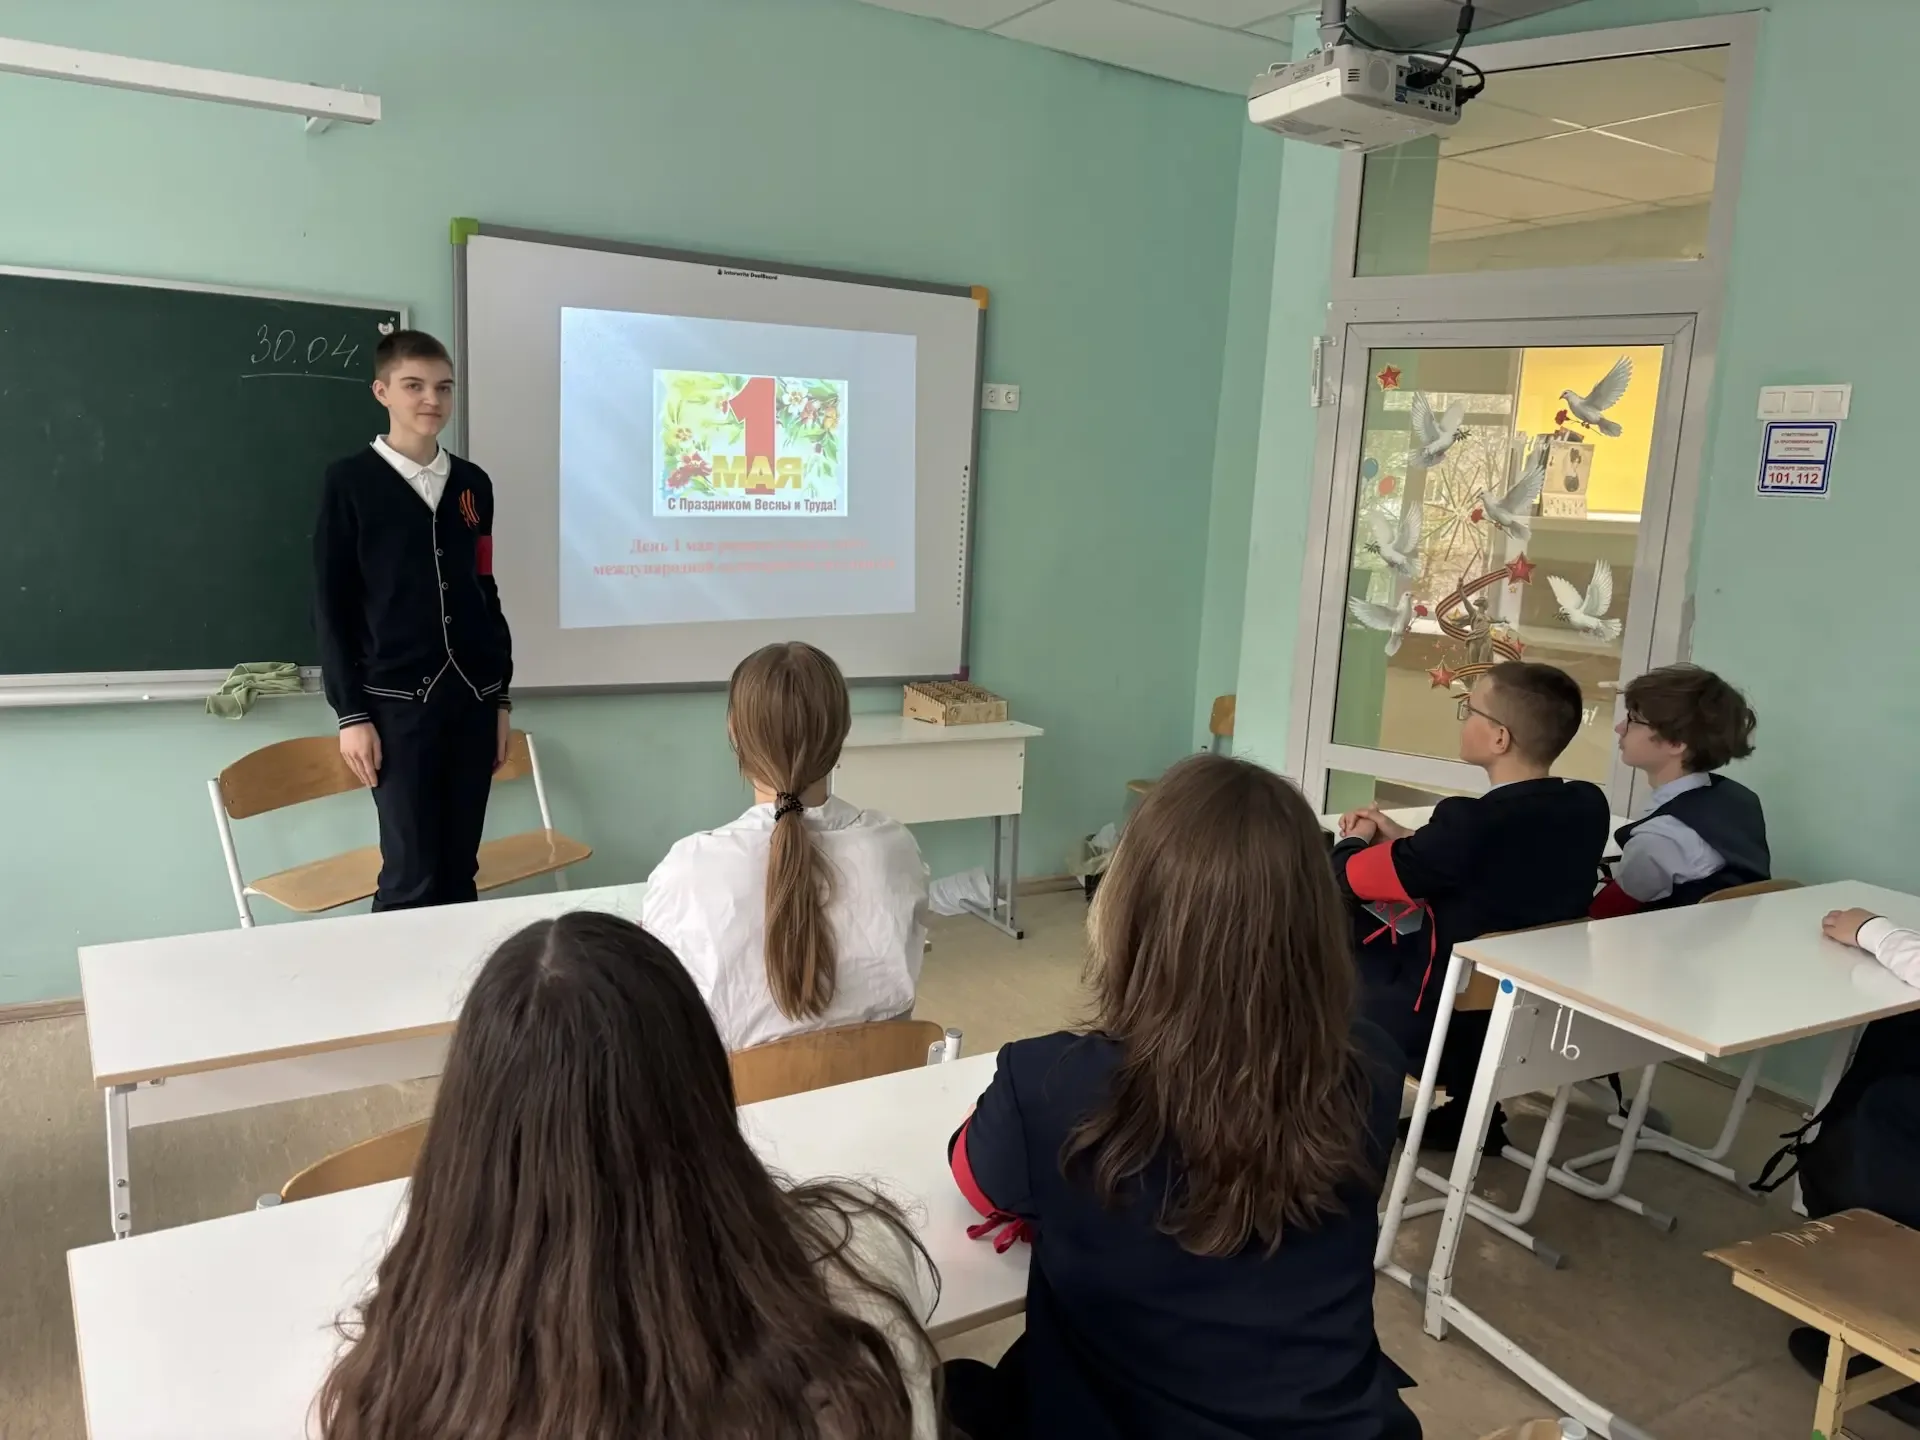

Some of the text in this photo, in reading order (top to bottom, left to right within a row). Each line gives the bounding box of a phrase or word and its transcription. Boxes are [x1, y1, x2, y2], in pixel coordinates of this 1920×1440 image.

[250, 323, 360, 369] 30.04.
[728, 377, 776, 495] 1
[712, 455, 803, 490] МАЯ
[1768, 472, 1819, 486] 101, 112
[667, 498, 837, 513] С Праздником Весны и Труда!
[629, 538, 669, 555] День
[674, 538, 681, 552] 1
